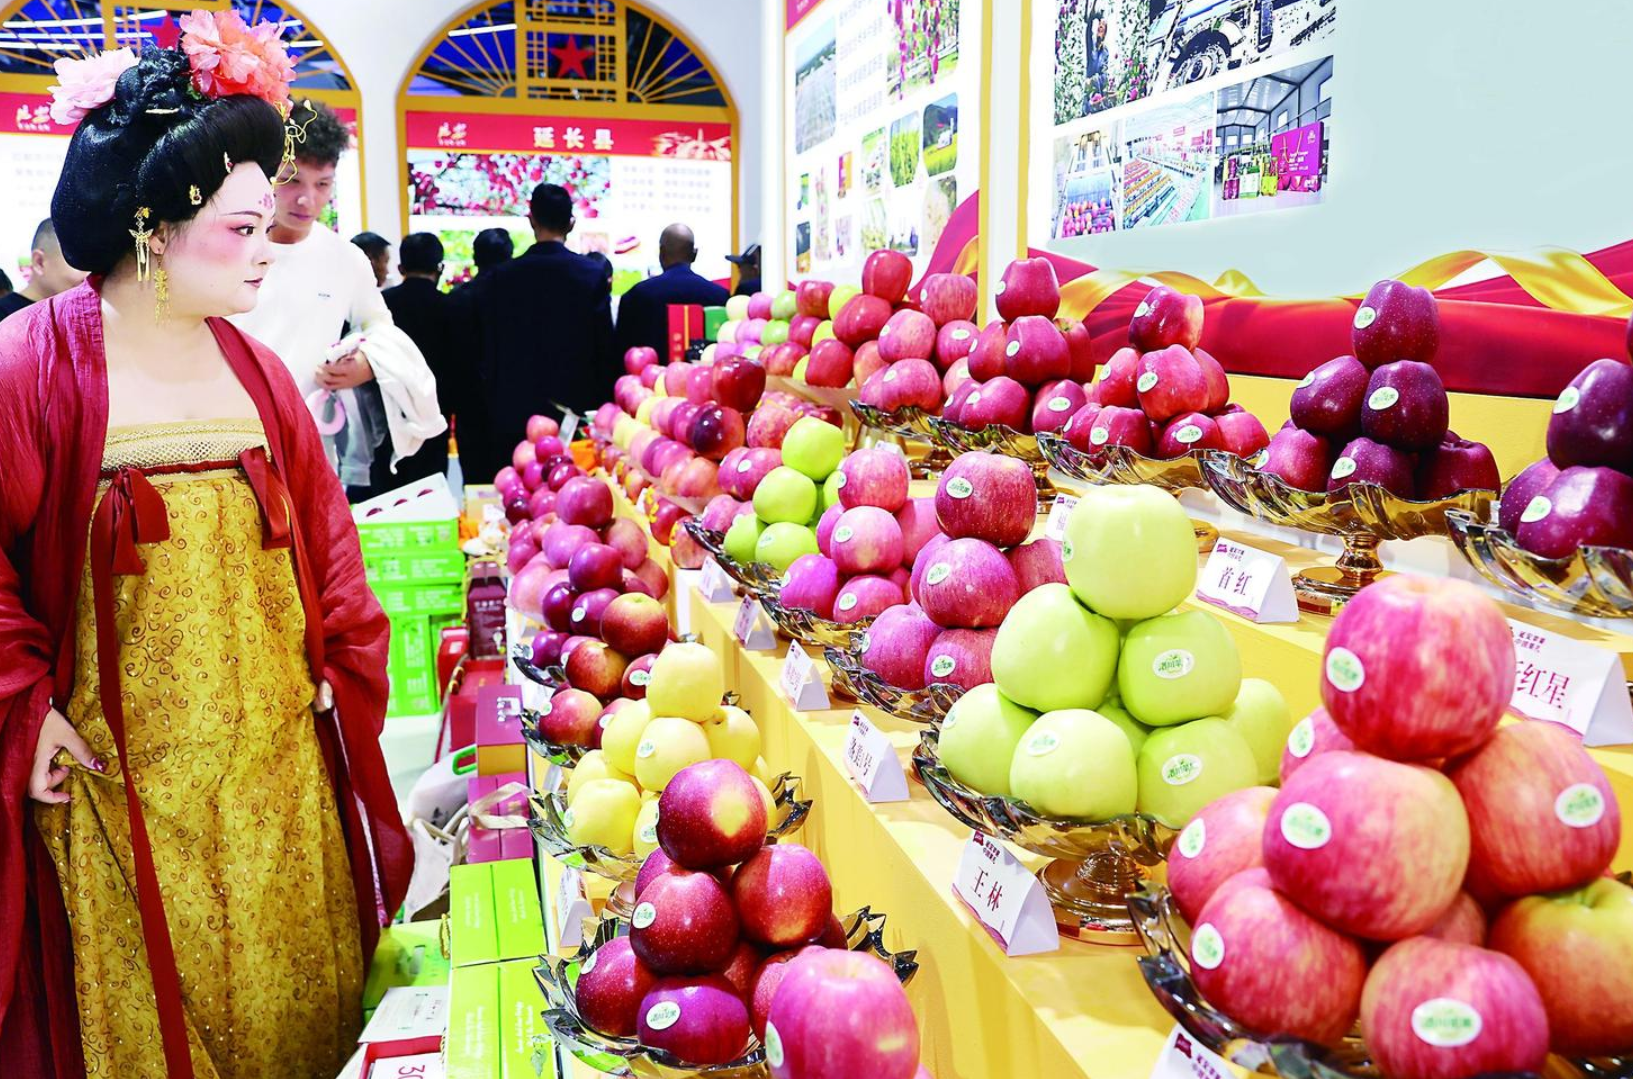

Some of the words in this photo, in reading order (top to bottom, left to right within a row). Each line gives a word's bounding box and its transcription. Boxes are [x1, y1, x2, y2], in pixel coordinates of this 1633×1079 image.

[532, 125, 615, 151] 延长县
[1216, 565, 1253, 596] 首红
[1515, 660, 1570, 709] 红星
[969, 865, 1004, 912] 王林
